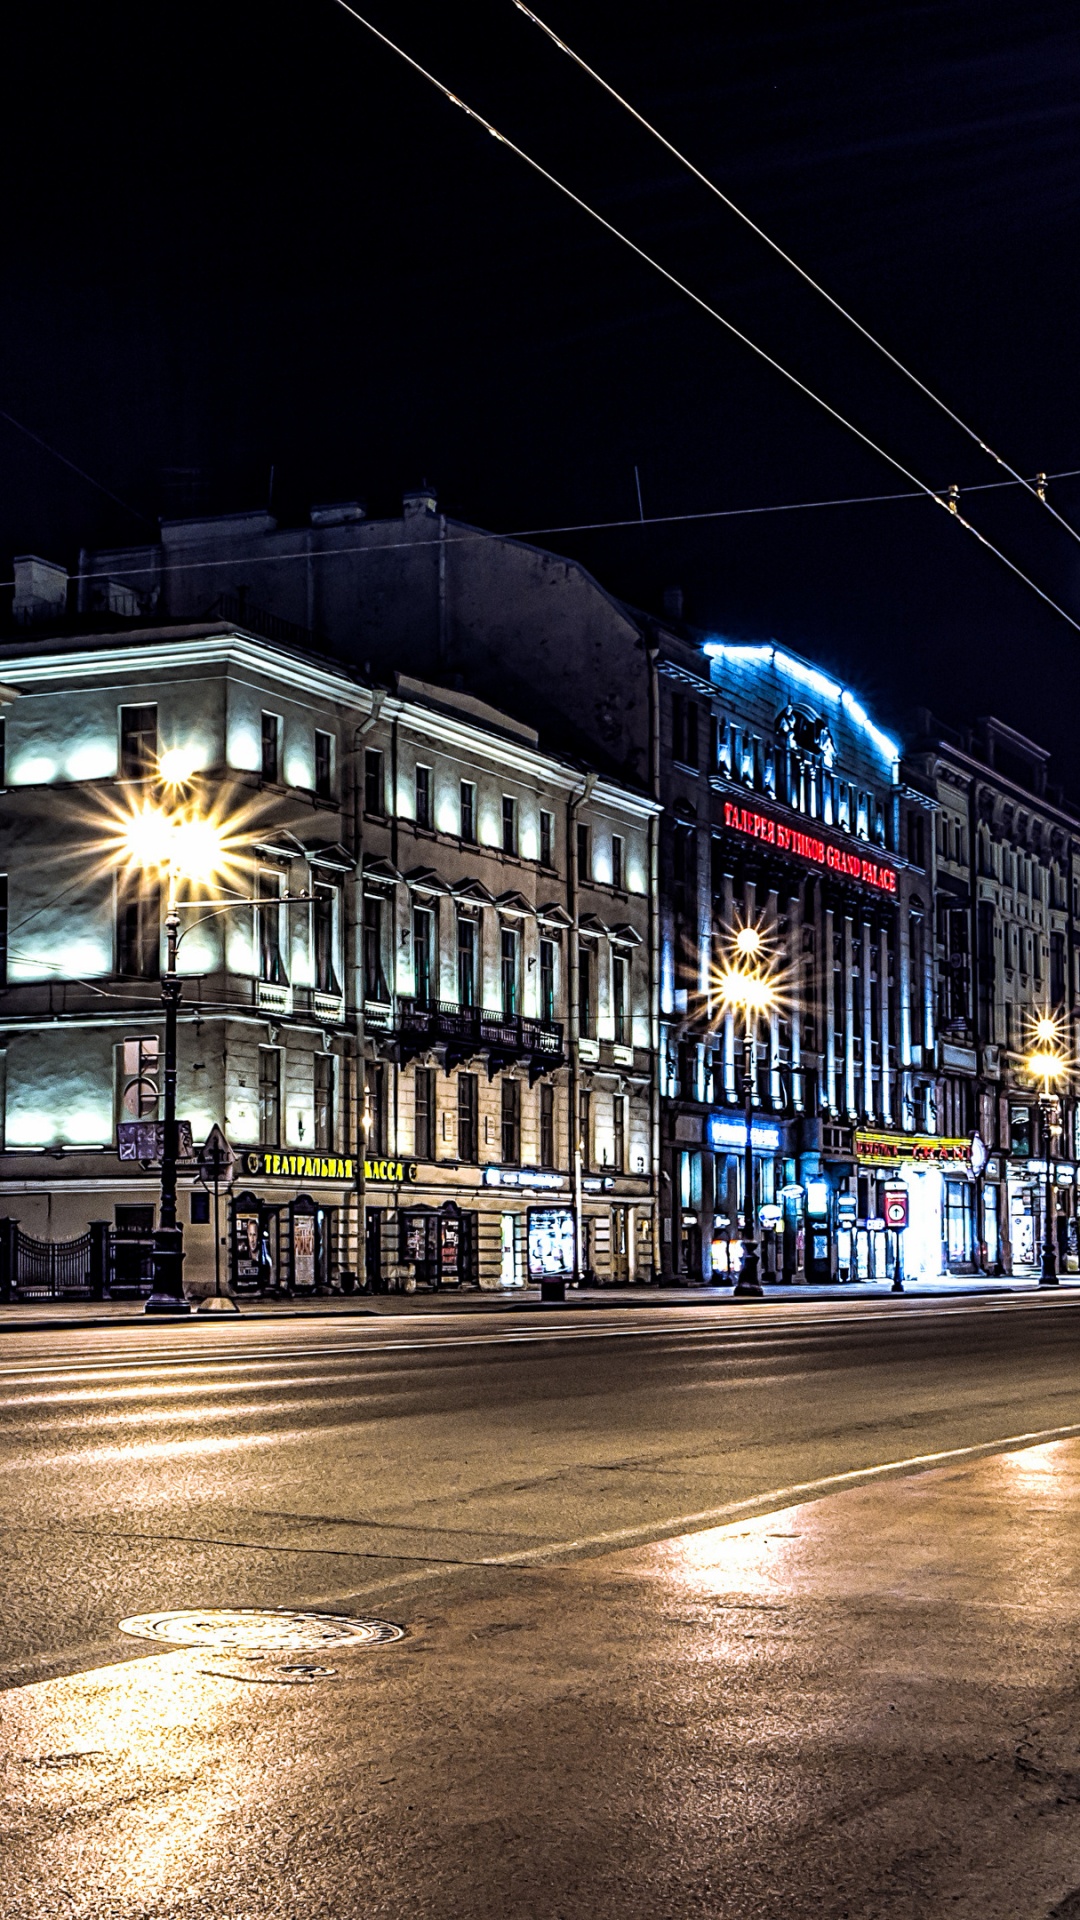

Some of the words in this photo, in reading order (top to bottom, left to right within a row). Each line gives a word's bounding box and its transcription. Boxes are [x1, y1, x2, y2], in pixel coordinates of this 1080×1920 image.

[723, 802, 775, 844] ГАЛЕРЕЯ
[776, 824, 825, 864] БУТИКОВ
[826, 846, 861, 878] GRAND
[861, 860, 897, 892] PALACE
[264, 1154, 353, 1178] ТЕАТРАЛЬНАЯ
[364, 1160, 404, 1181] КАССА
